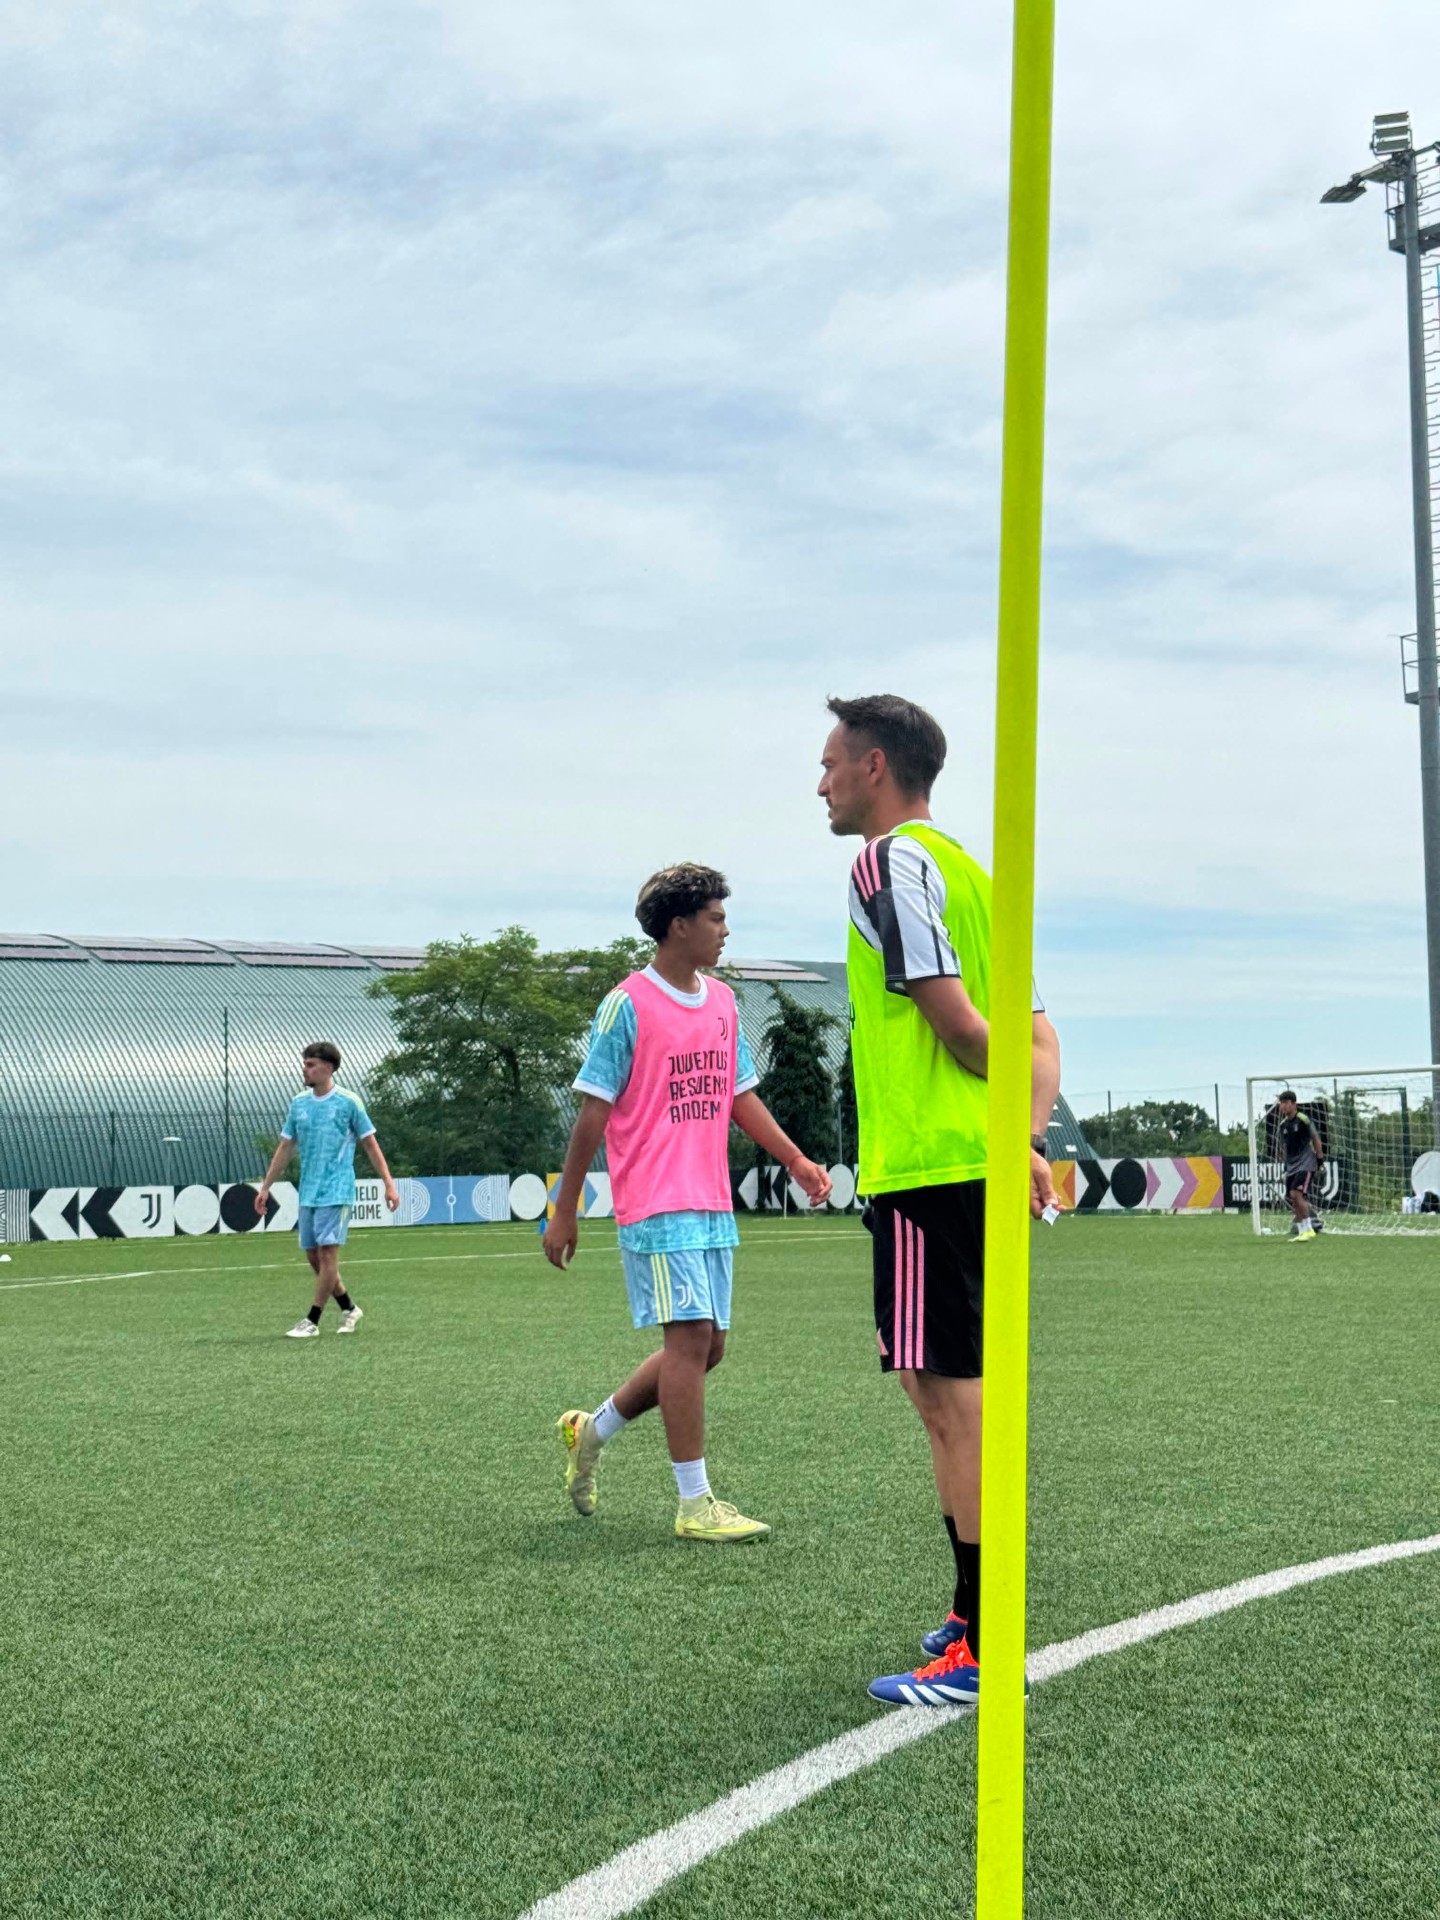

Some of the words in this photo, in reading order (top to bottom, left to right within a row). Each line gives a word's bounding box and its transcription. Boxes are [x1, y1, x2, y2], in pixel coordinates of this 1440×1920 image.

[1231, 1163, 1285, 1181] JUVNTU
[355, 1185, 379, 1201] IELD
[350, 1203, 382, 1220] HOME
